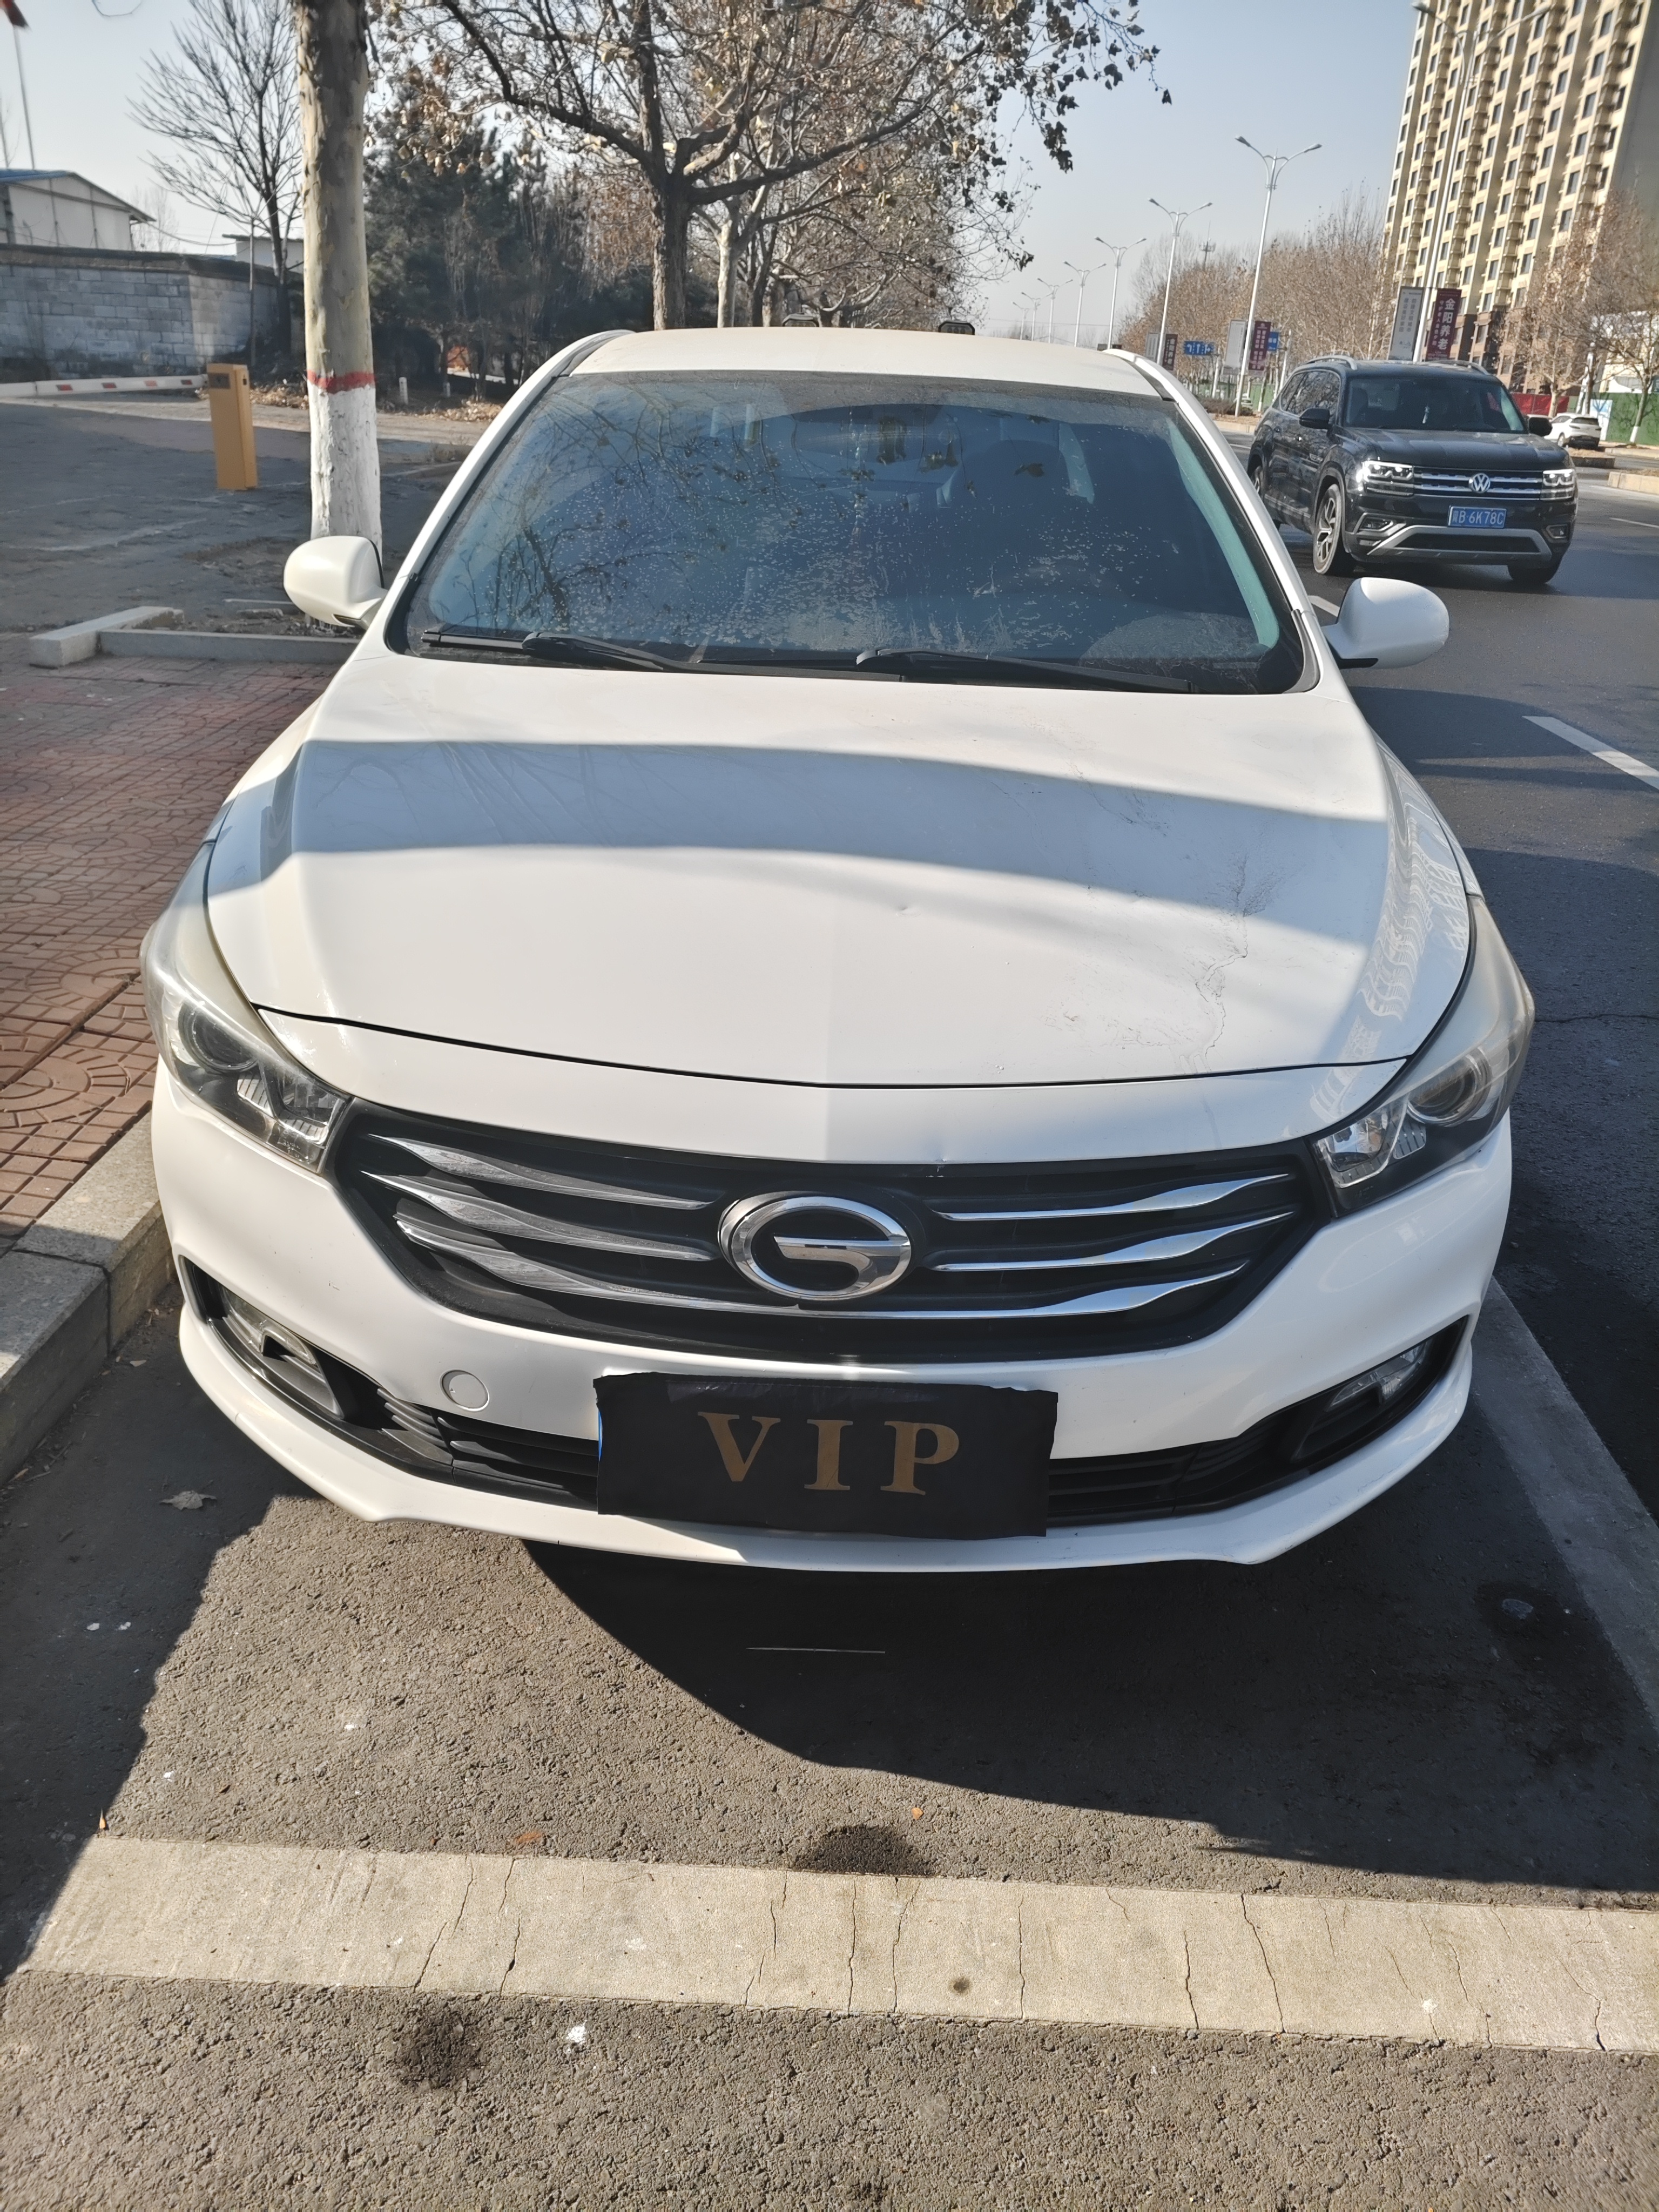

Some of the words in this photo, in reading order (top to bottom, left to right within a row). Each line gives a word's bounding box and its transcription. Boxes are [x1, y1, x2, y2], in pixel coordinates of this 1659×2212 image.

[1438, 298, 1456, 350] 金阳养老
[698, 1411, 960, 1496] VIP
